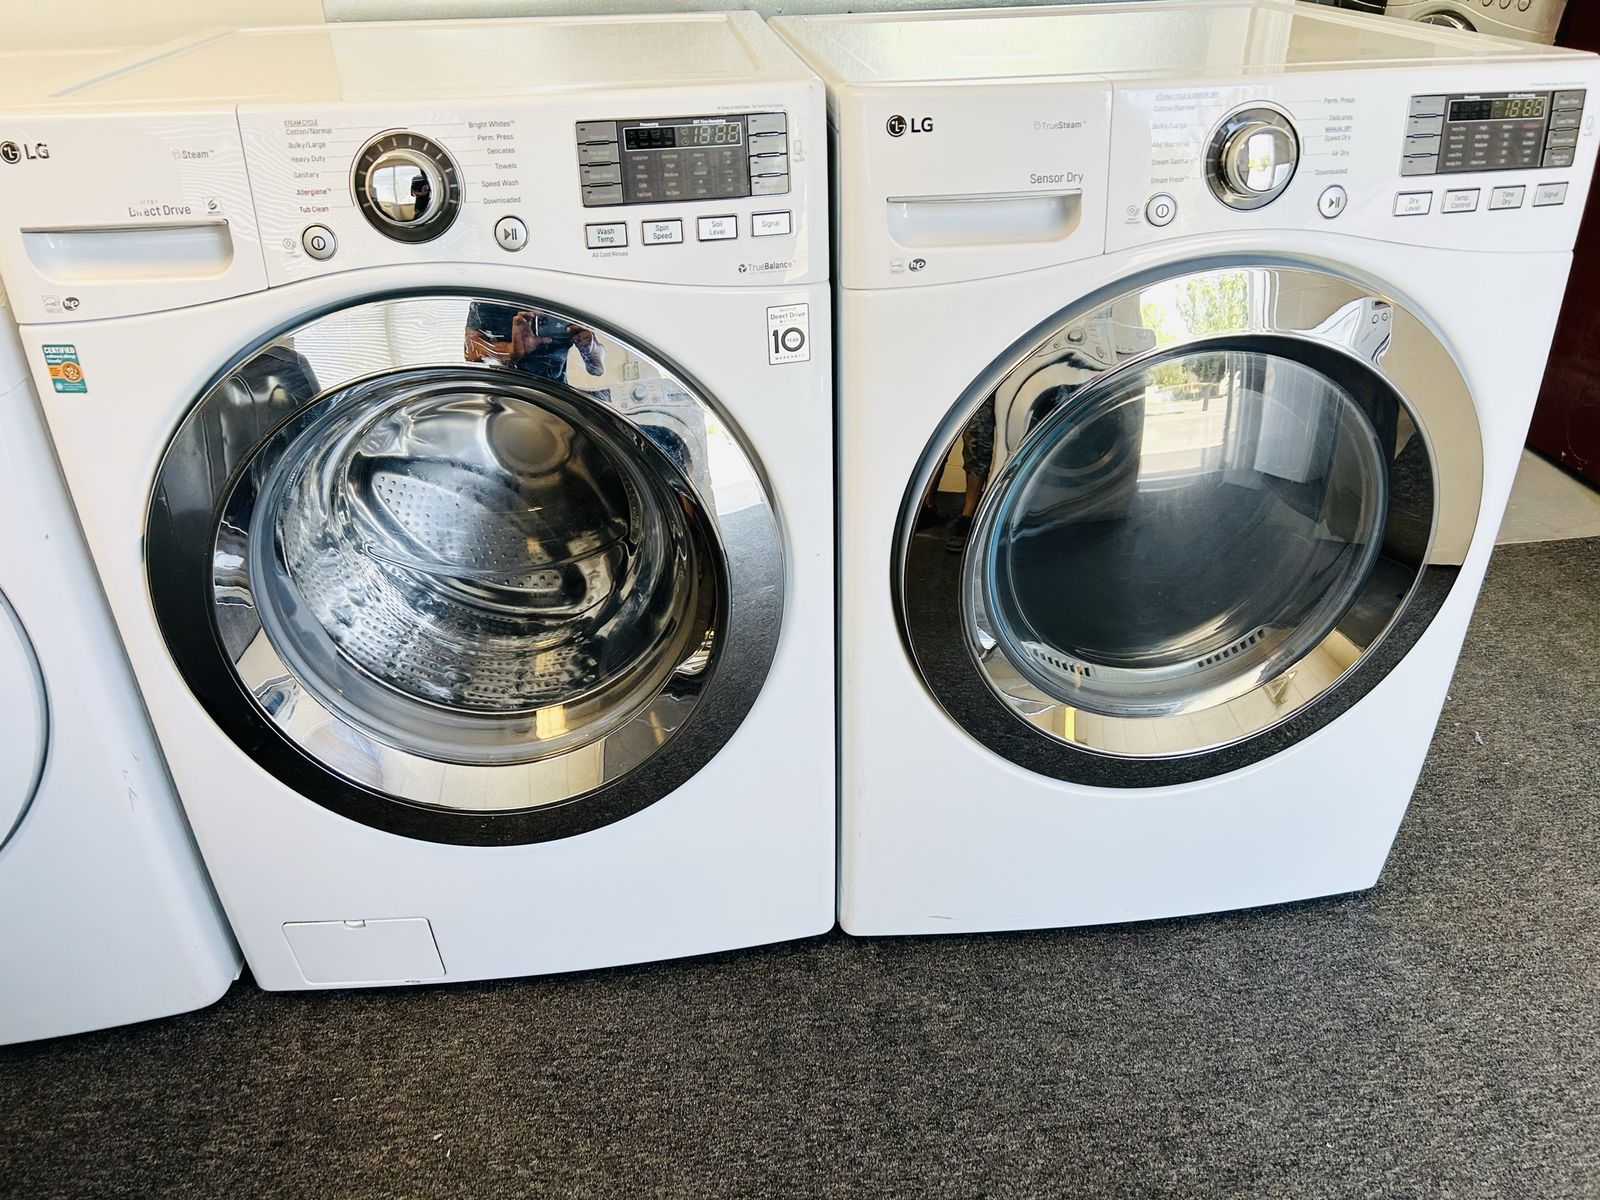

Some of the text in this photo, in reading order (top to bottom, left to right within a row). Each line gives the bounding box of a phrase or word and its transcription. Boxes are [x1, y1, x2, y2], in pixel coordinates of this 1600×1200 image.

[302, 118, 318, 126] CYCLE
[468, 121, 488, 129] Bright
[911, 117, 934, 133] LG
[285, 128, 333, 136] Cotton/Normal
[496, 133, 514, 141] Press
[288, 141, 326, 150] Bulky/Large
[23, 143, 50, 160] LG
[486, 147, 516, 155] Delicates
[290, 155, 326, 164] Heavy Duty
[495, 162, 517, 170] Towels
[294, 171, 320, 179] Sanitary
[1315, 168, 1348, 176] Downloaded
[1030, 172, 1084, 184] Sensor Dry
[481, 179, 519, 188] Speed Wash
[1543, 191, 1559, 199] Signal
[483, 197, 521, 205] Downloaded
[1450, 201, 1471, 209] Control
[163, 204, 192, 216] Drive
[312, 205, 329, 213] Clean
[1405, 204, 1421, 212] Level
[711, 220, 723, 228] Soil
[761, 220, 781, 229] Signal
[655, 224, 670, 233] Spin
[709, 228, 726, 236] Level
[653, 232, 673, 240] Speed
[770, 312, 788, 320] Direct
[772, 327, 805, 354] 10
[44, 346, 76, 354] CERTIFIED
